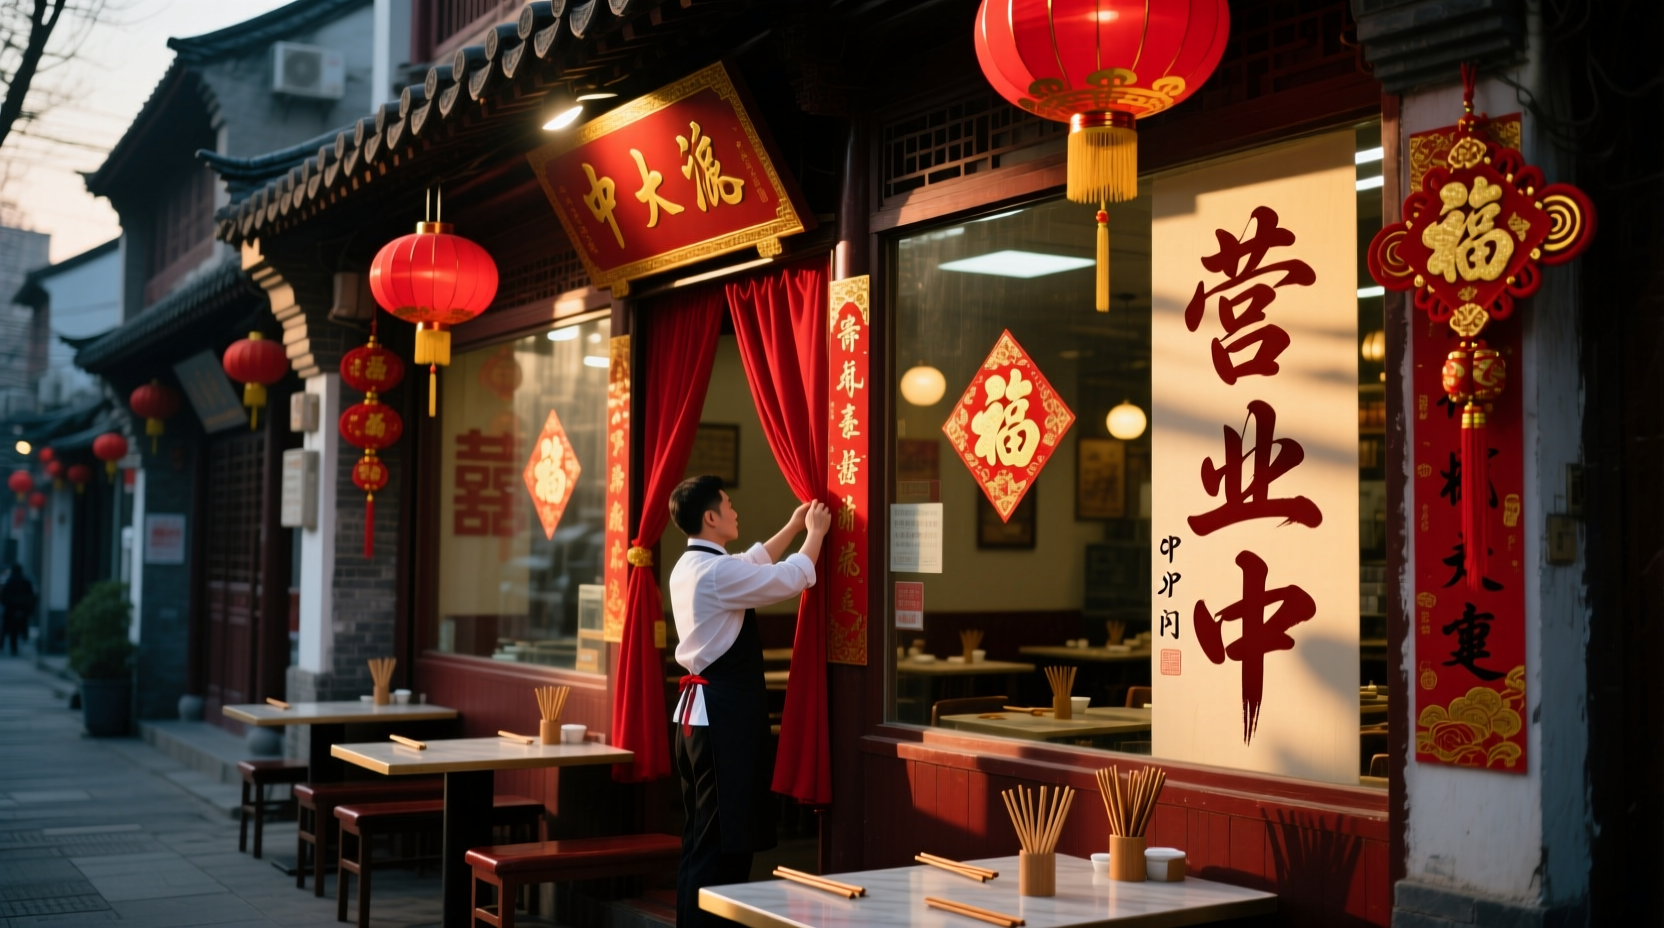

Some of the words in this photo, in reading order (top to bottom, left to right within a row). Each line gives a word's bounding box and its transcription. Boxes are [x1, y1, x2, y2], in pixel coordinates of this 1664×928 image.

[1422, 175, 1515, 284] 福
[534, 434, 567, 505] 福
[971, 368, 1041, 468] 福
[1184, 205, 1323, 748] 营业中
